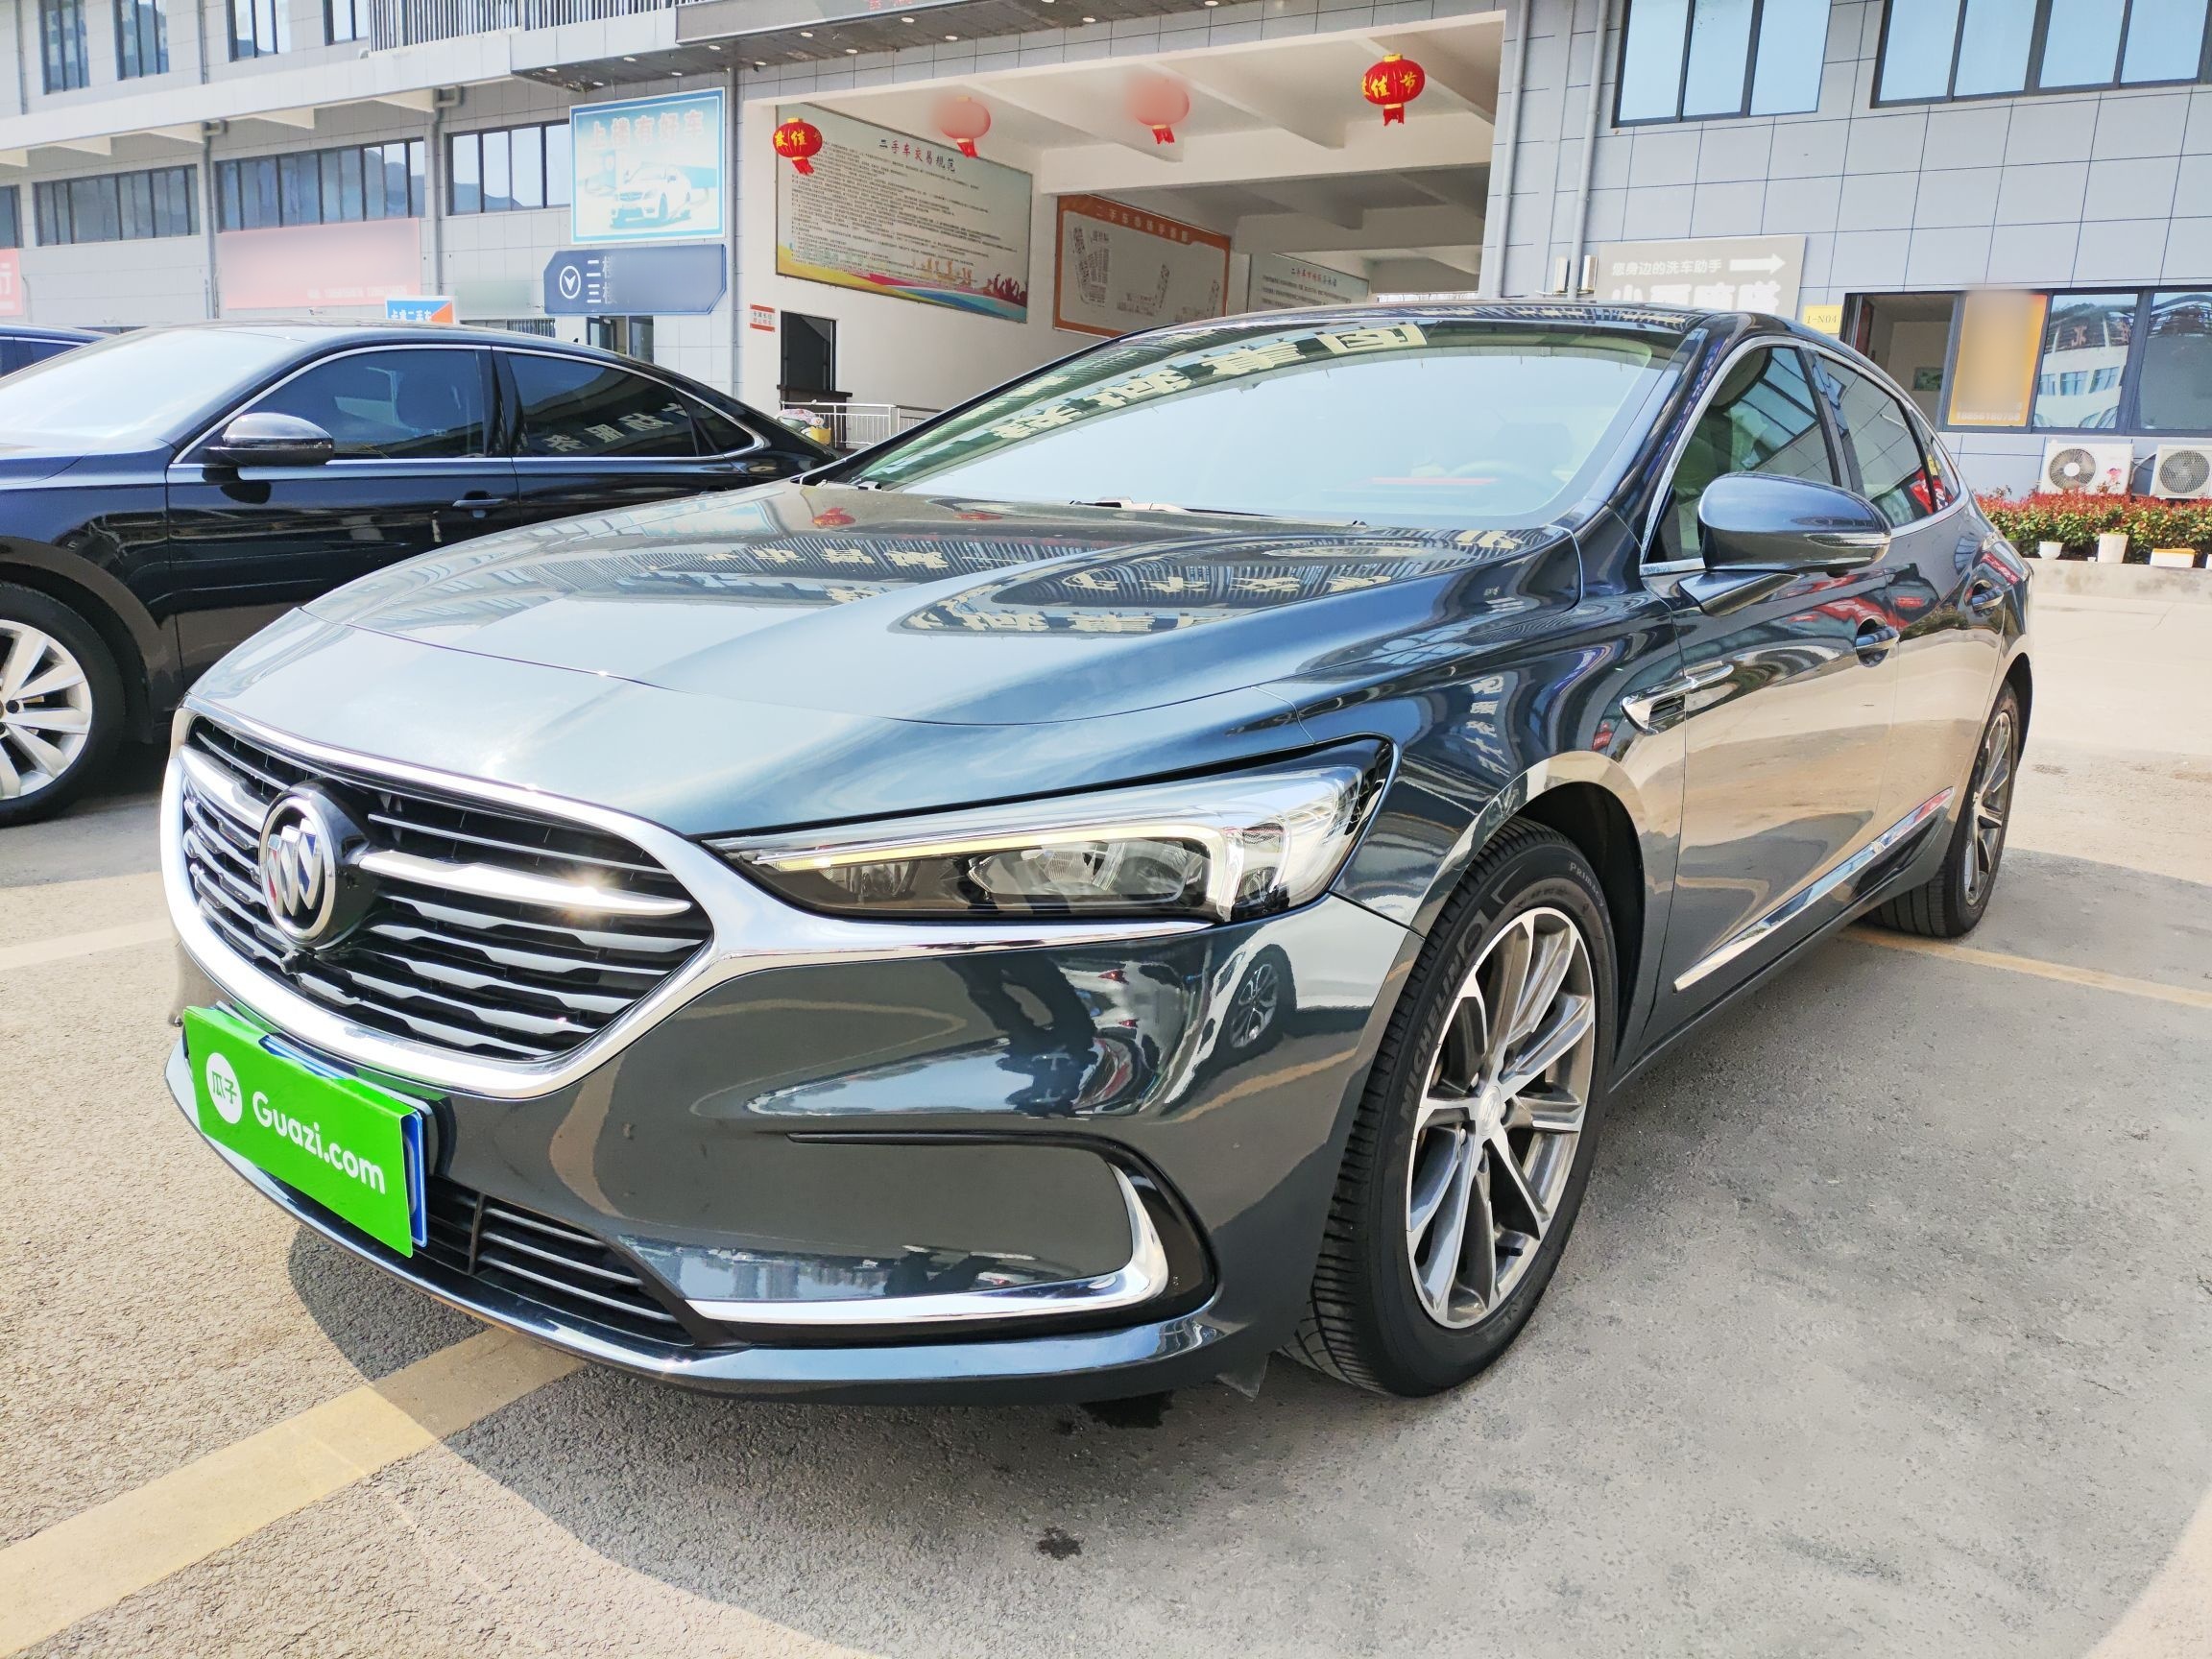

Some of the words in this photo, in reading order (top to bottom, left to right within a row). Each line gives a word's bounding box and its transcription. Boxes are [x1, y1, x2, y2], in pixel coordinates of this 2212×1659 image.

[589, 110, 705, 149] 上楼有好车
[775, 130, 822, 149] 度佳
[878, 139, 956, 173] 二手车交易规范
[1612, 259, 1722, 277] 您身边的洗车助手
[1400, 950, 1467, 1124] MICHELIN
[210, 1069, 238, 1105] 瓜子
[252, 1091, 386, 1195] Guazi.com
